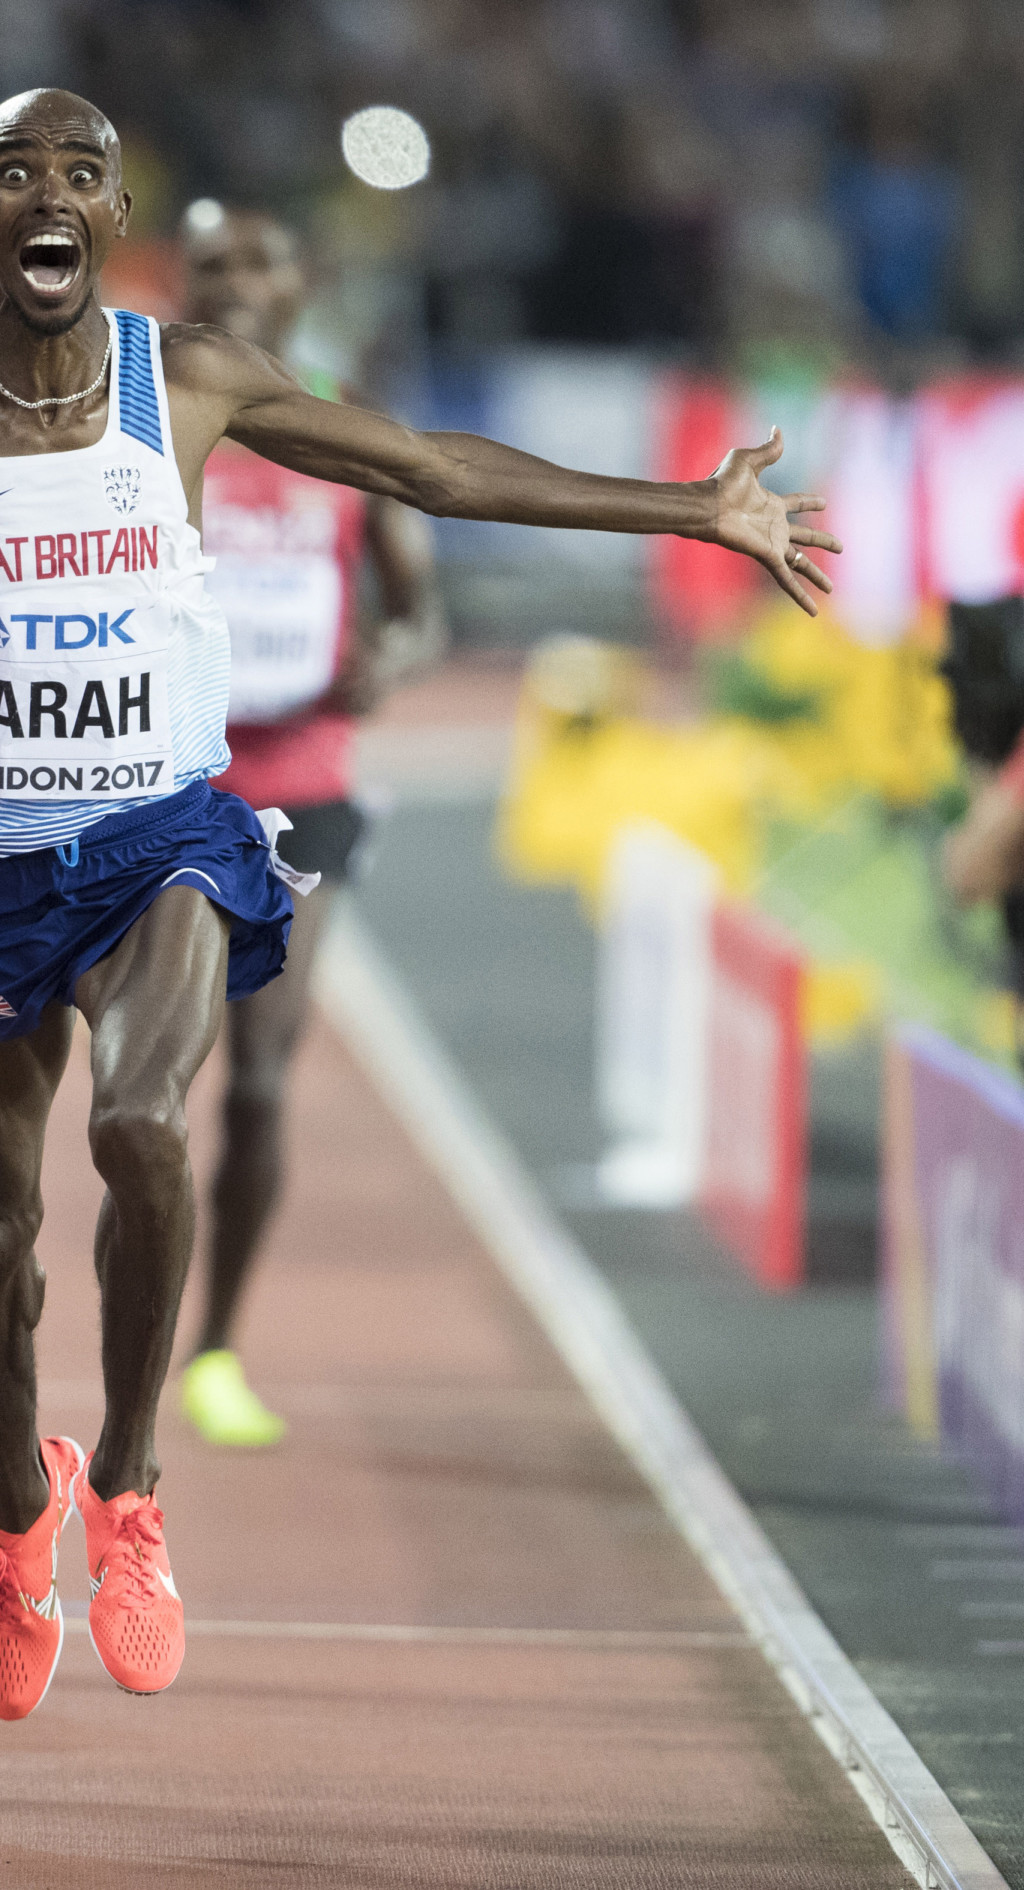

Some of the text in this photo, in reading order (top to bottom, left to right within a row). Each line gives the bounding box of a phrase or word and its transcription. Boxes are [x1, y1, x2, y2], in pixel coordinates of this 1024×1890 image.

[34, 525, 159, 580] BRITAIN
[10, 607, 137, 651] TDK
[90, 759, 165, 792] 2017
